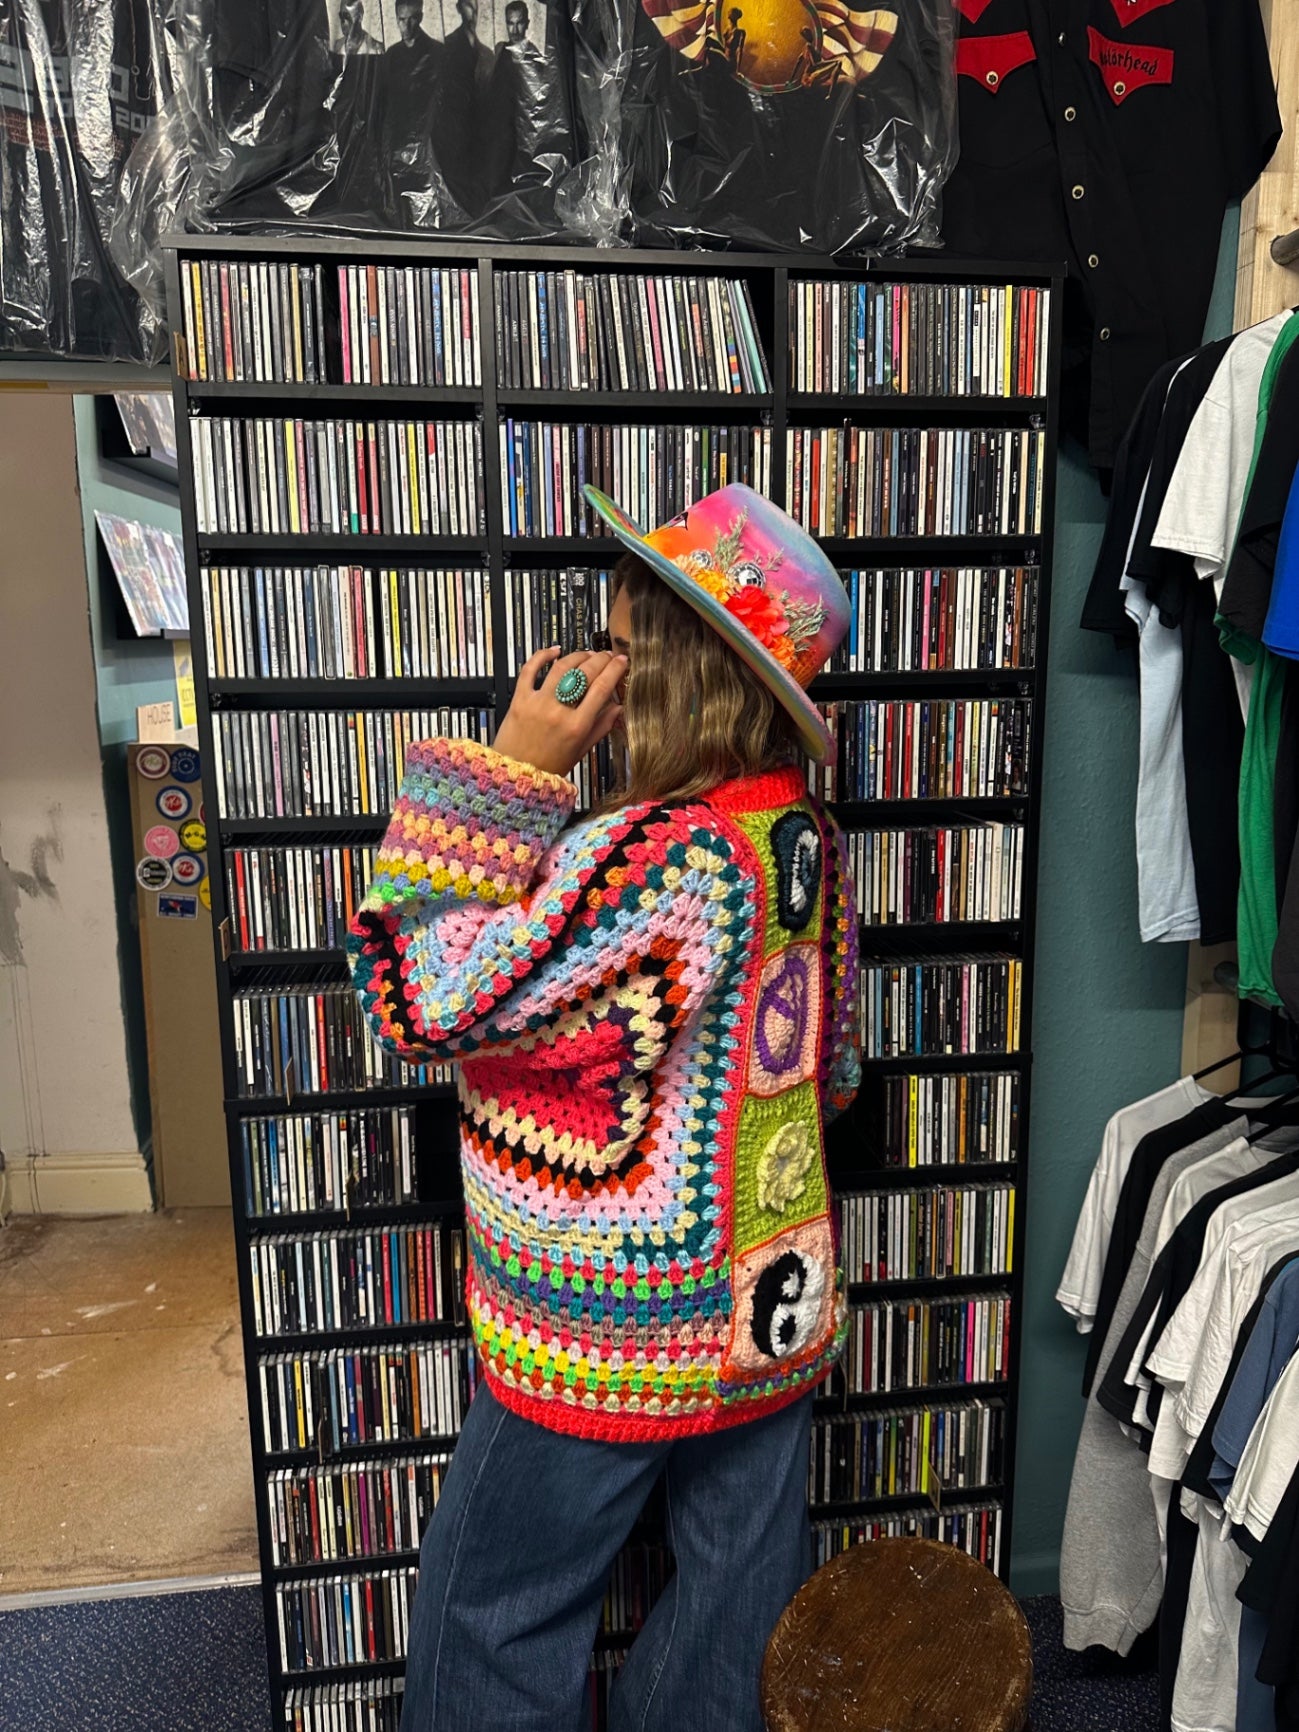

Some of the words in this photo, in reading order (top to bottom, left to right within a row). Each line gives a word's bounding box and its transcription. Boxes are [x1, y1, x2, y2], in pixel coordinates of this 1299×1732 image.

[575, 597, 584, 620] CHAS
[576, 628, 585, 649] DAVE
[146, 703, 172, 725] HOUSE
